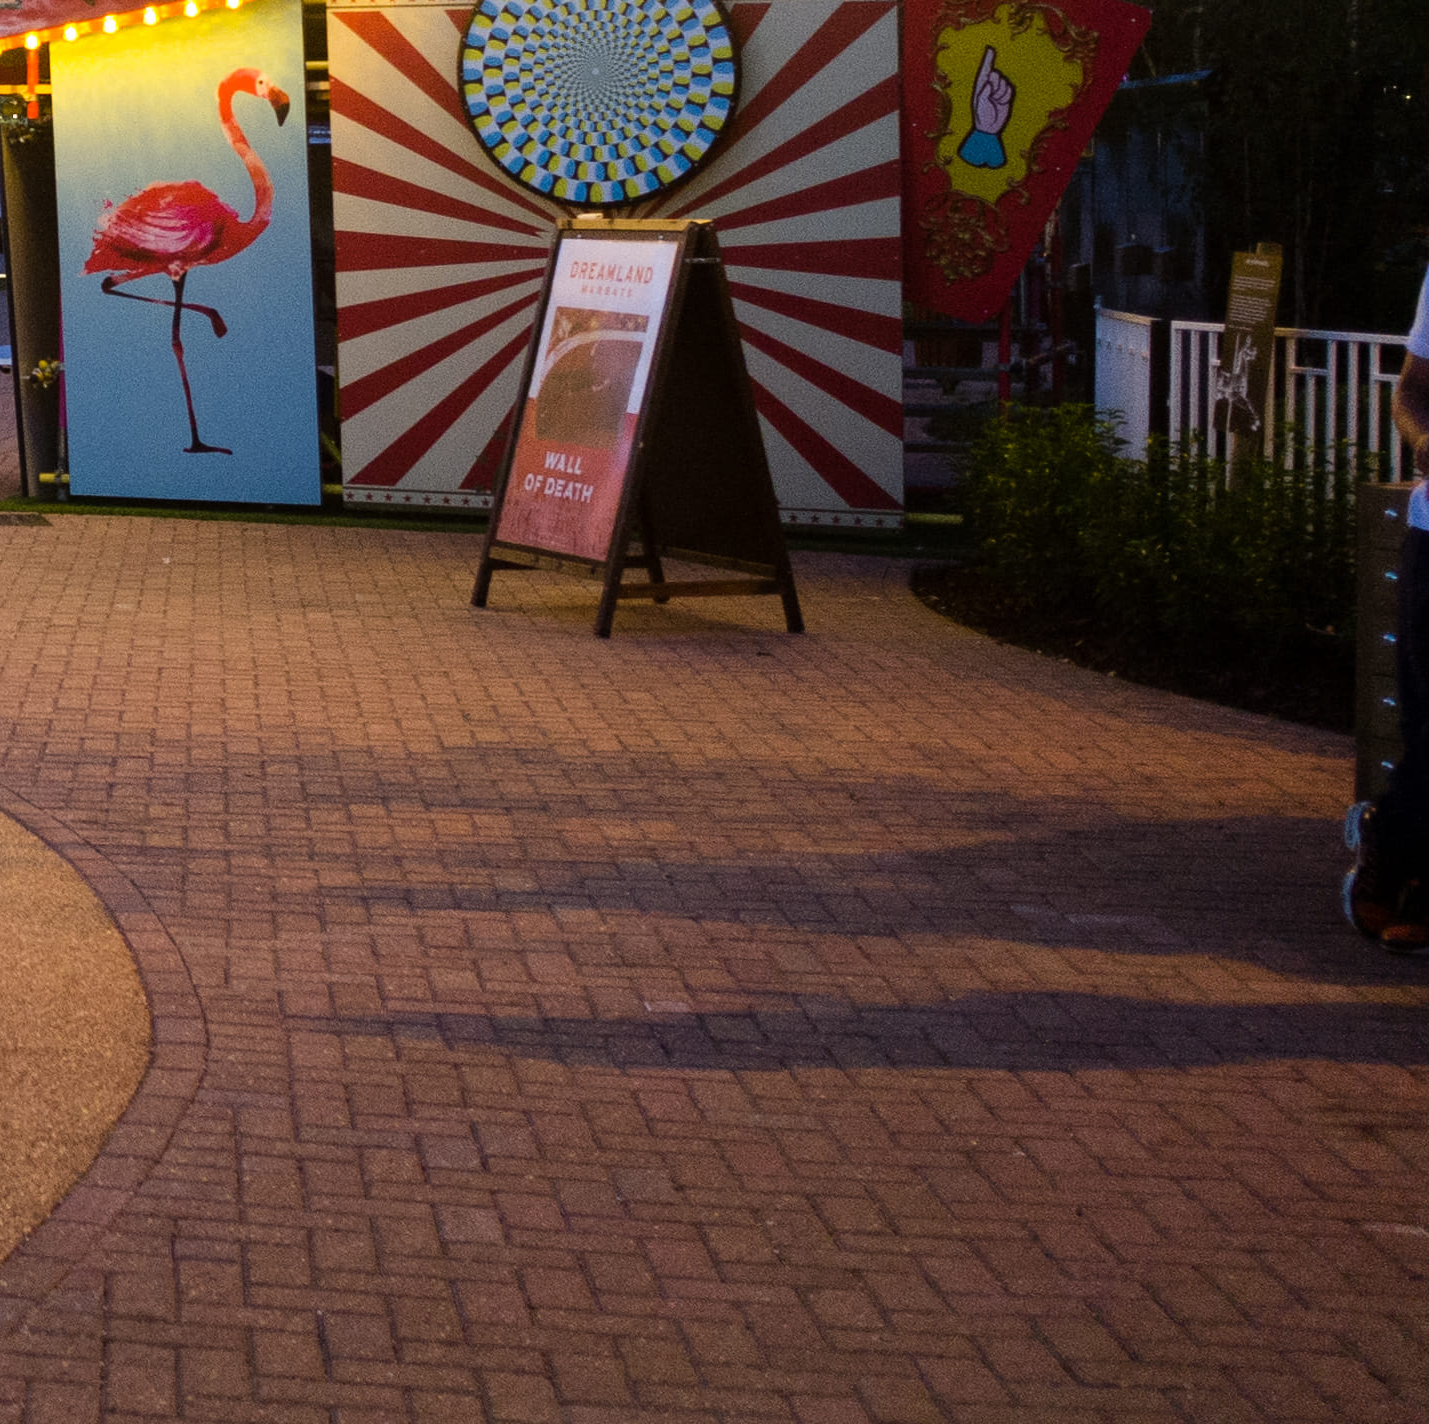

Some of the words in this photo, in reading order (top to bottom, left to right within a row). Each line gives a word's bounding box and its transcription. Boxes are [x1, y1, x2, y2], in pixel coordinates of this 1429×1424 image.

[570, 261, 654, 284] DREAMLAND
[545, 451, 582, 474] WALL
[525, 473, 543, 492] OF
[545, 478, 594, 503] DEATH
